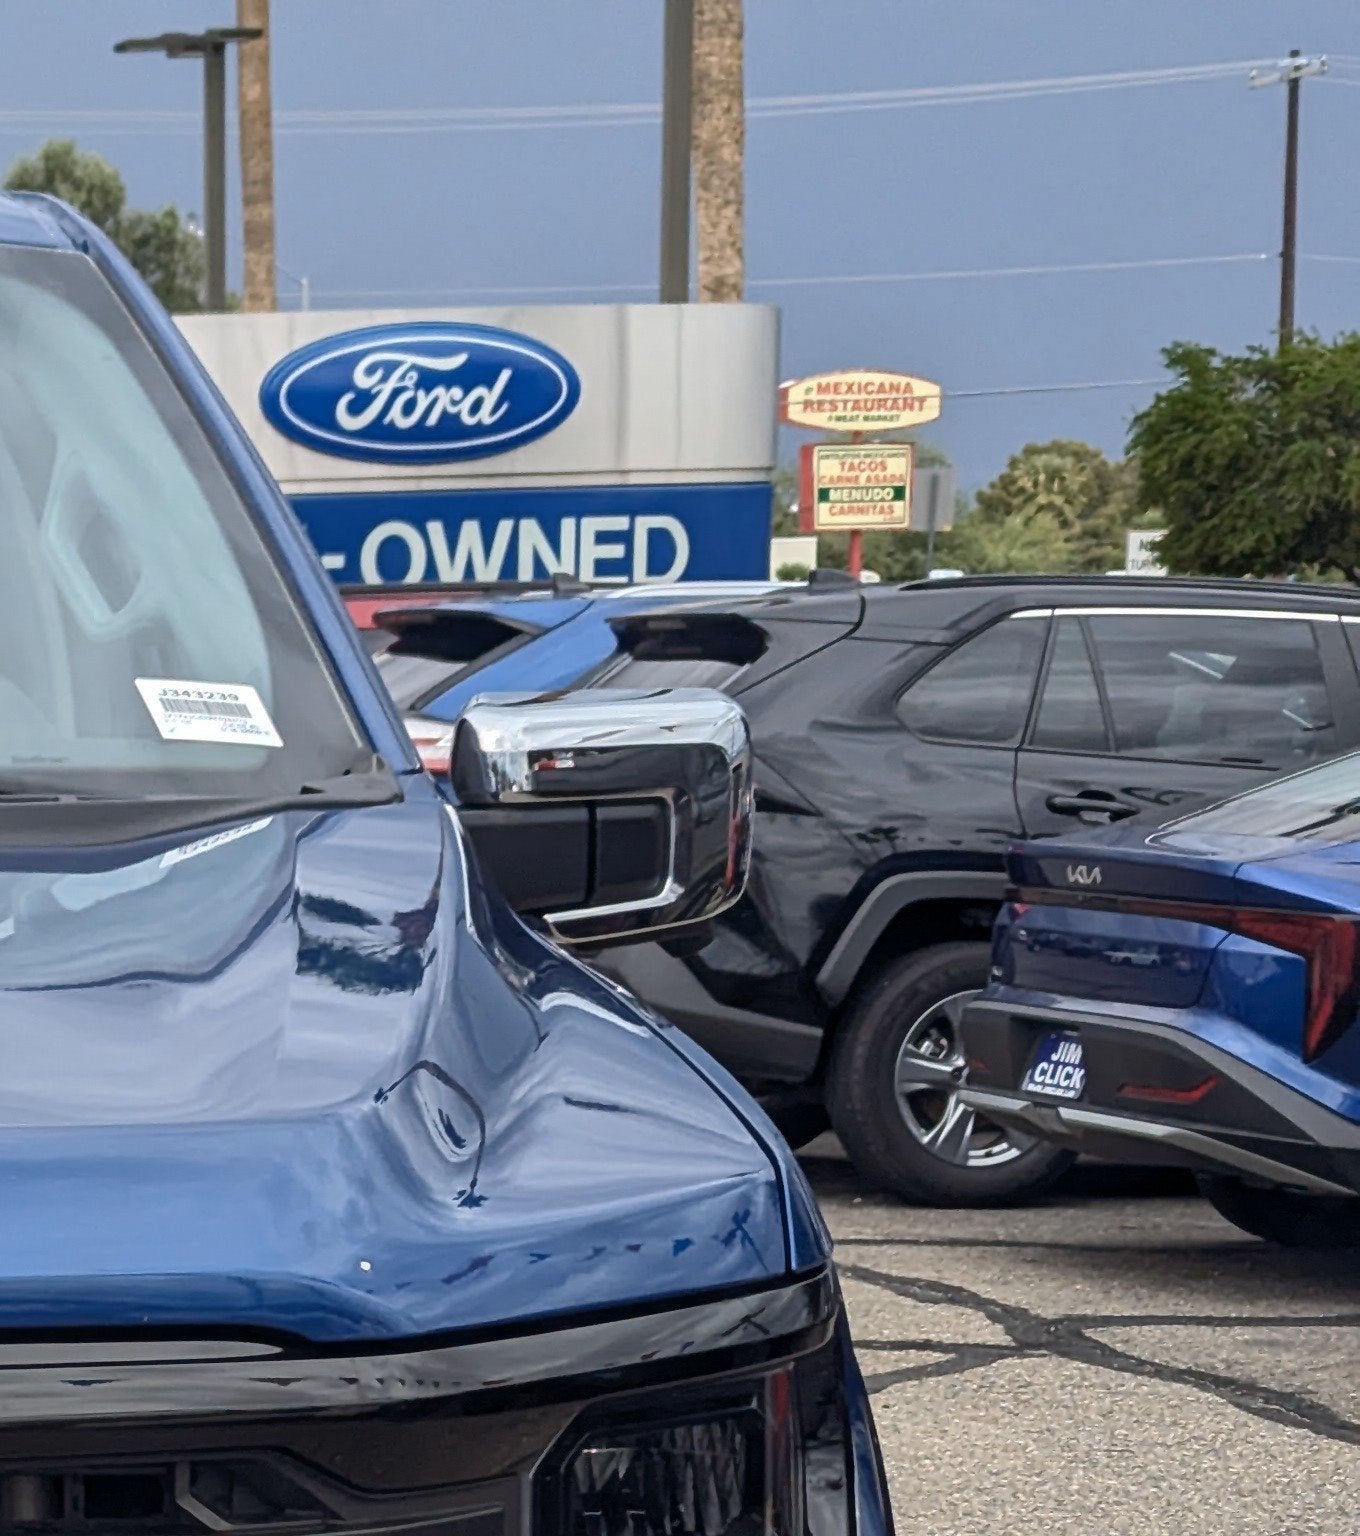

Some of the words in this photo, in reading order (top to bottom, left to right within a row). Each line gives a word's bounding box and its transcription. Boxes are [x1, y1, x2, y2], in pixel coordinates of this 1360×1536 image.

[335, 351, 513, 431] Ford
[816, 382, 914, 396] MEXICANA
[803, 398, 927, 413] RESTAURANT
[839, 460, 888, 473] TACOS
[828, 487, 895, 501] MENUDO
[828, 504, 894, 517] CARNITAS
[1050, 1041, 1083, 1065] JIM
[1033, 1061, 1086, 1089] CLICK
